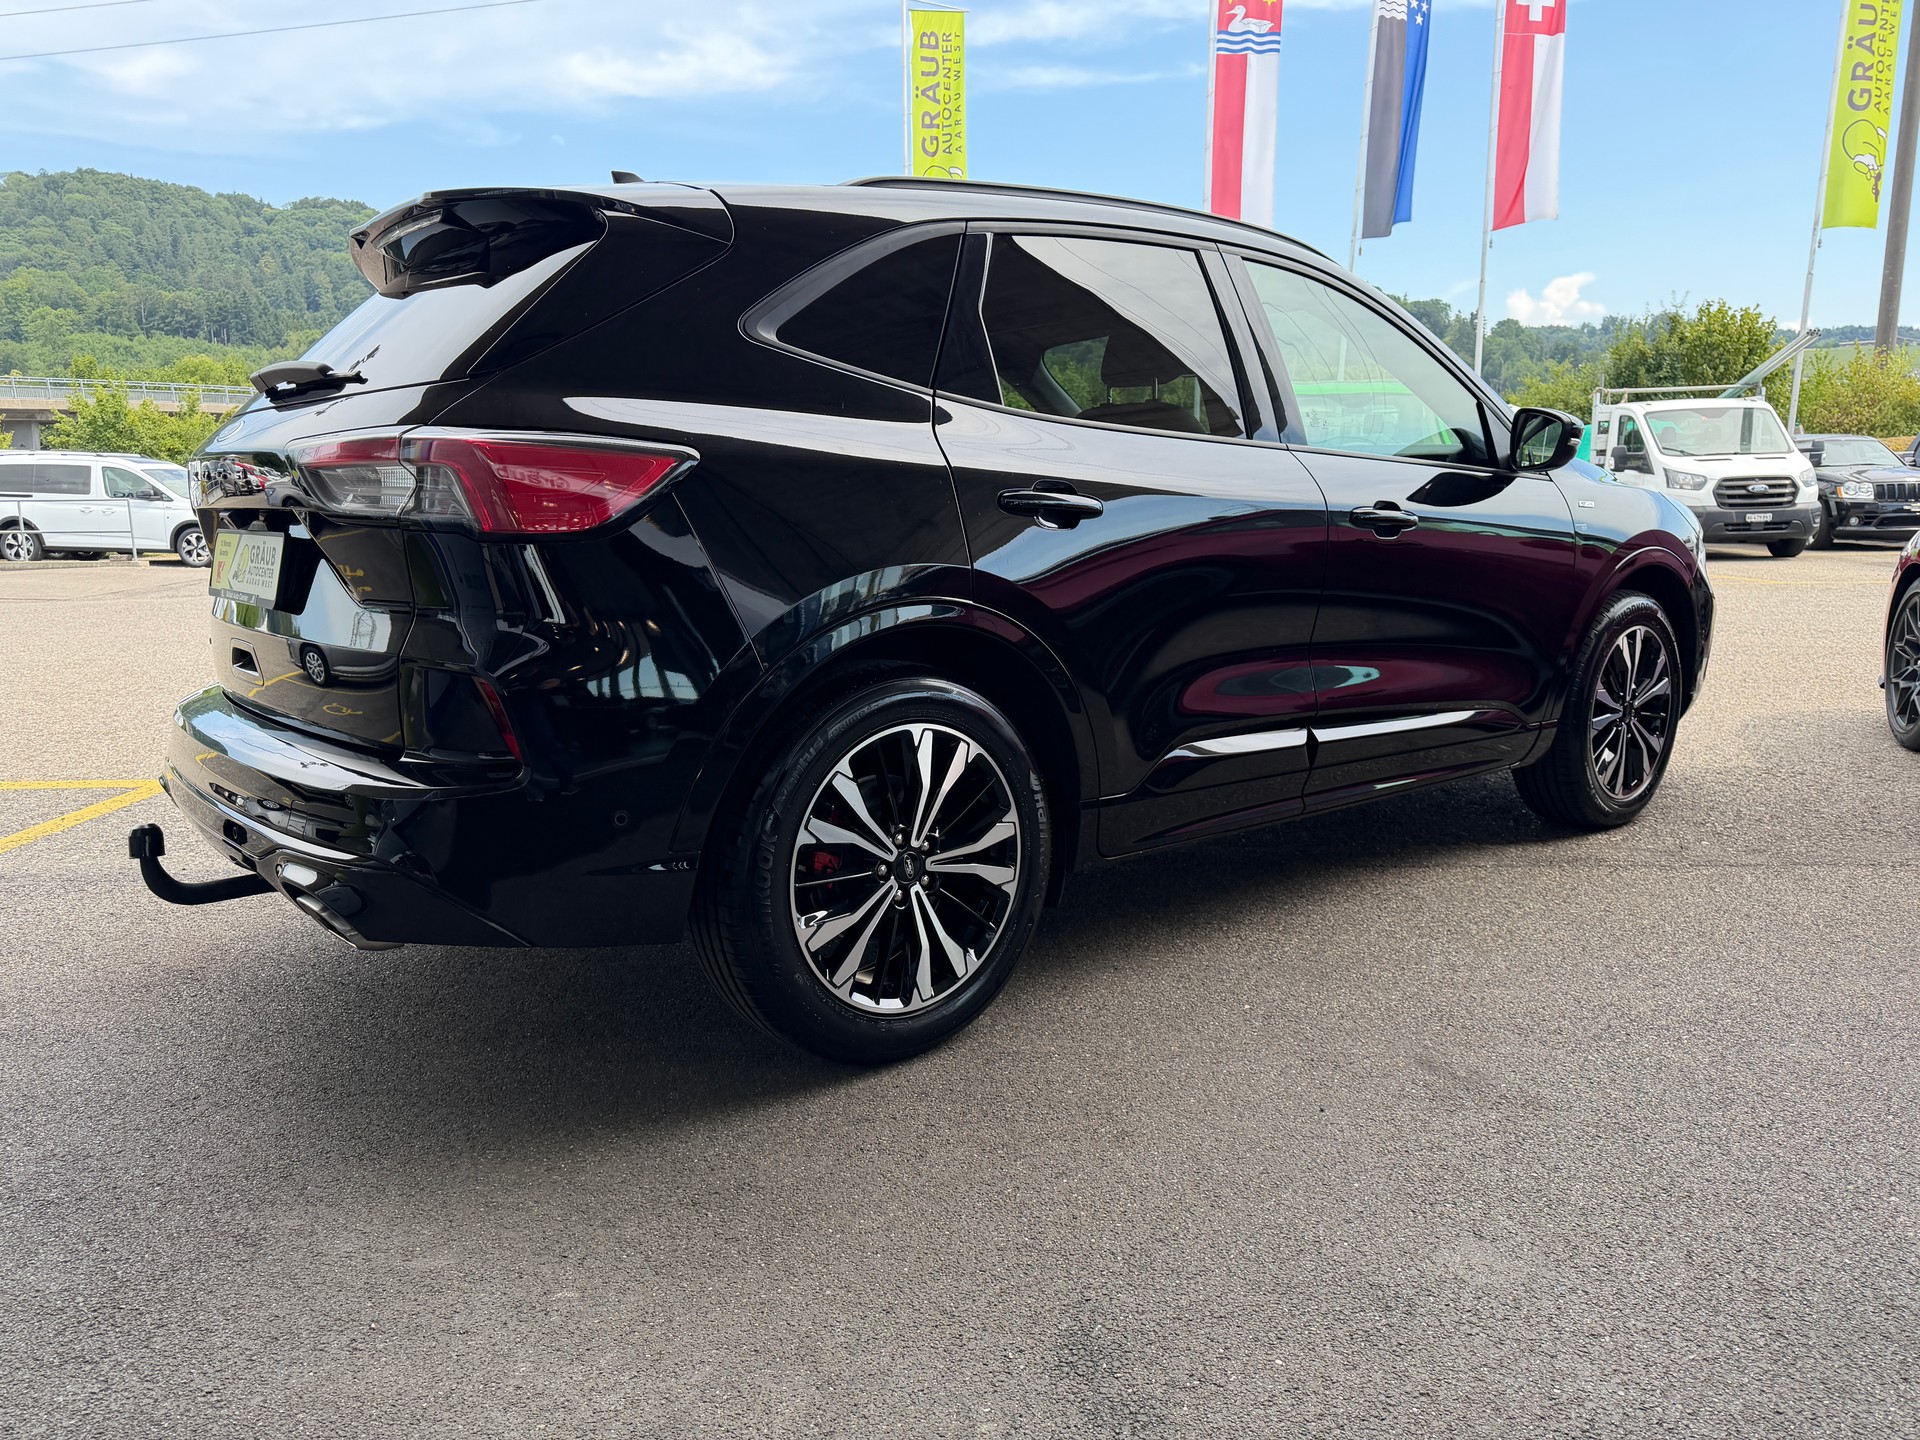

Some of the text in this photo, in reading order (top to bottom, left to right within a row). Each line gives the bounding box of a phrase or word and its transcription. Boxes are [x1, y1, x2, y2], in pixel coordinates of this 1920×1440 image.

[915, 30, 940, 158] GRÄUB
[942, 32, 953, 155] AUTOCENTER
[953, 32, 963, 153] AARAU WEST
[1846, 3, 1878, 111] GRÄU
[1883, 48, 1893, 115] AARAU
[247, 566, 274, 579] AUTOCENTER
[250, 541, 277, 566] GRÄUB
